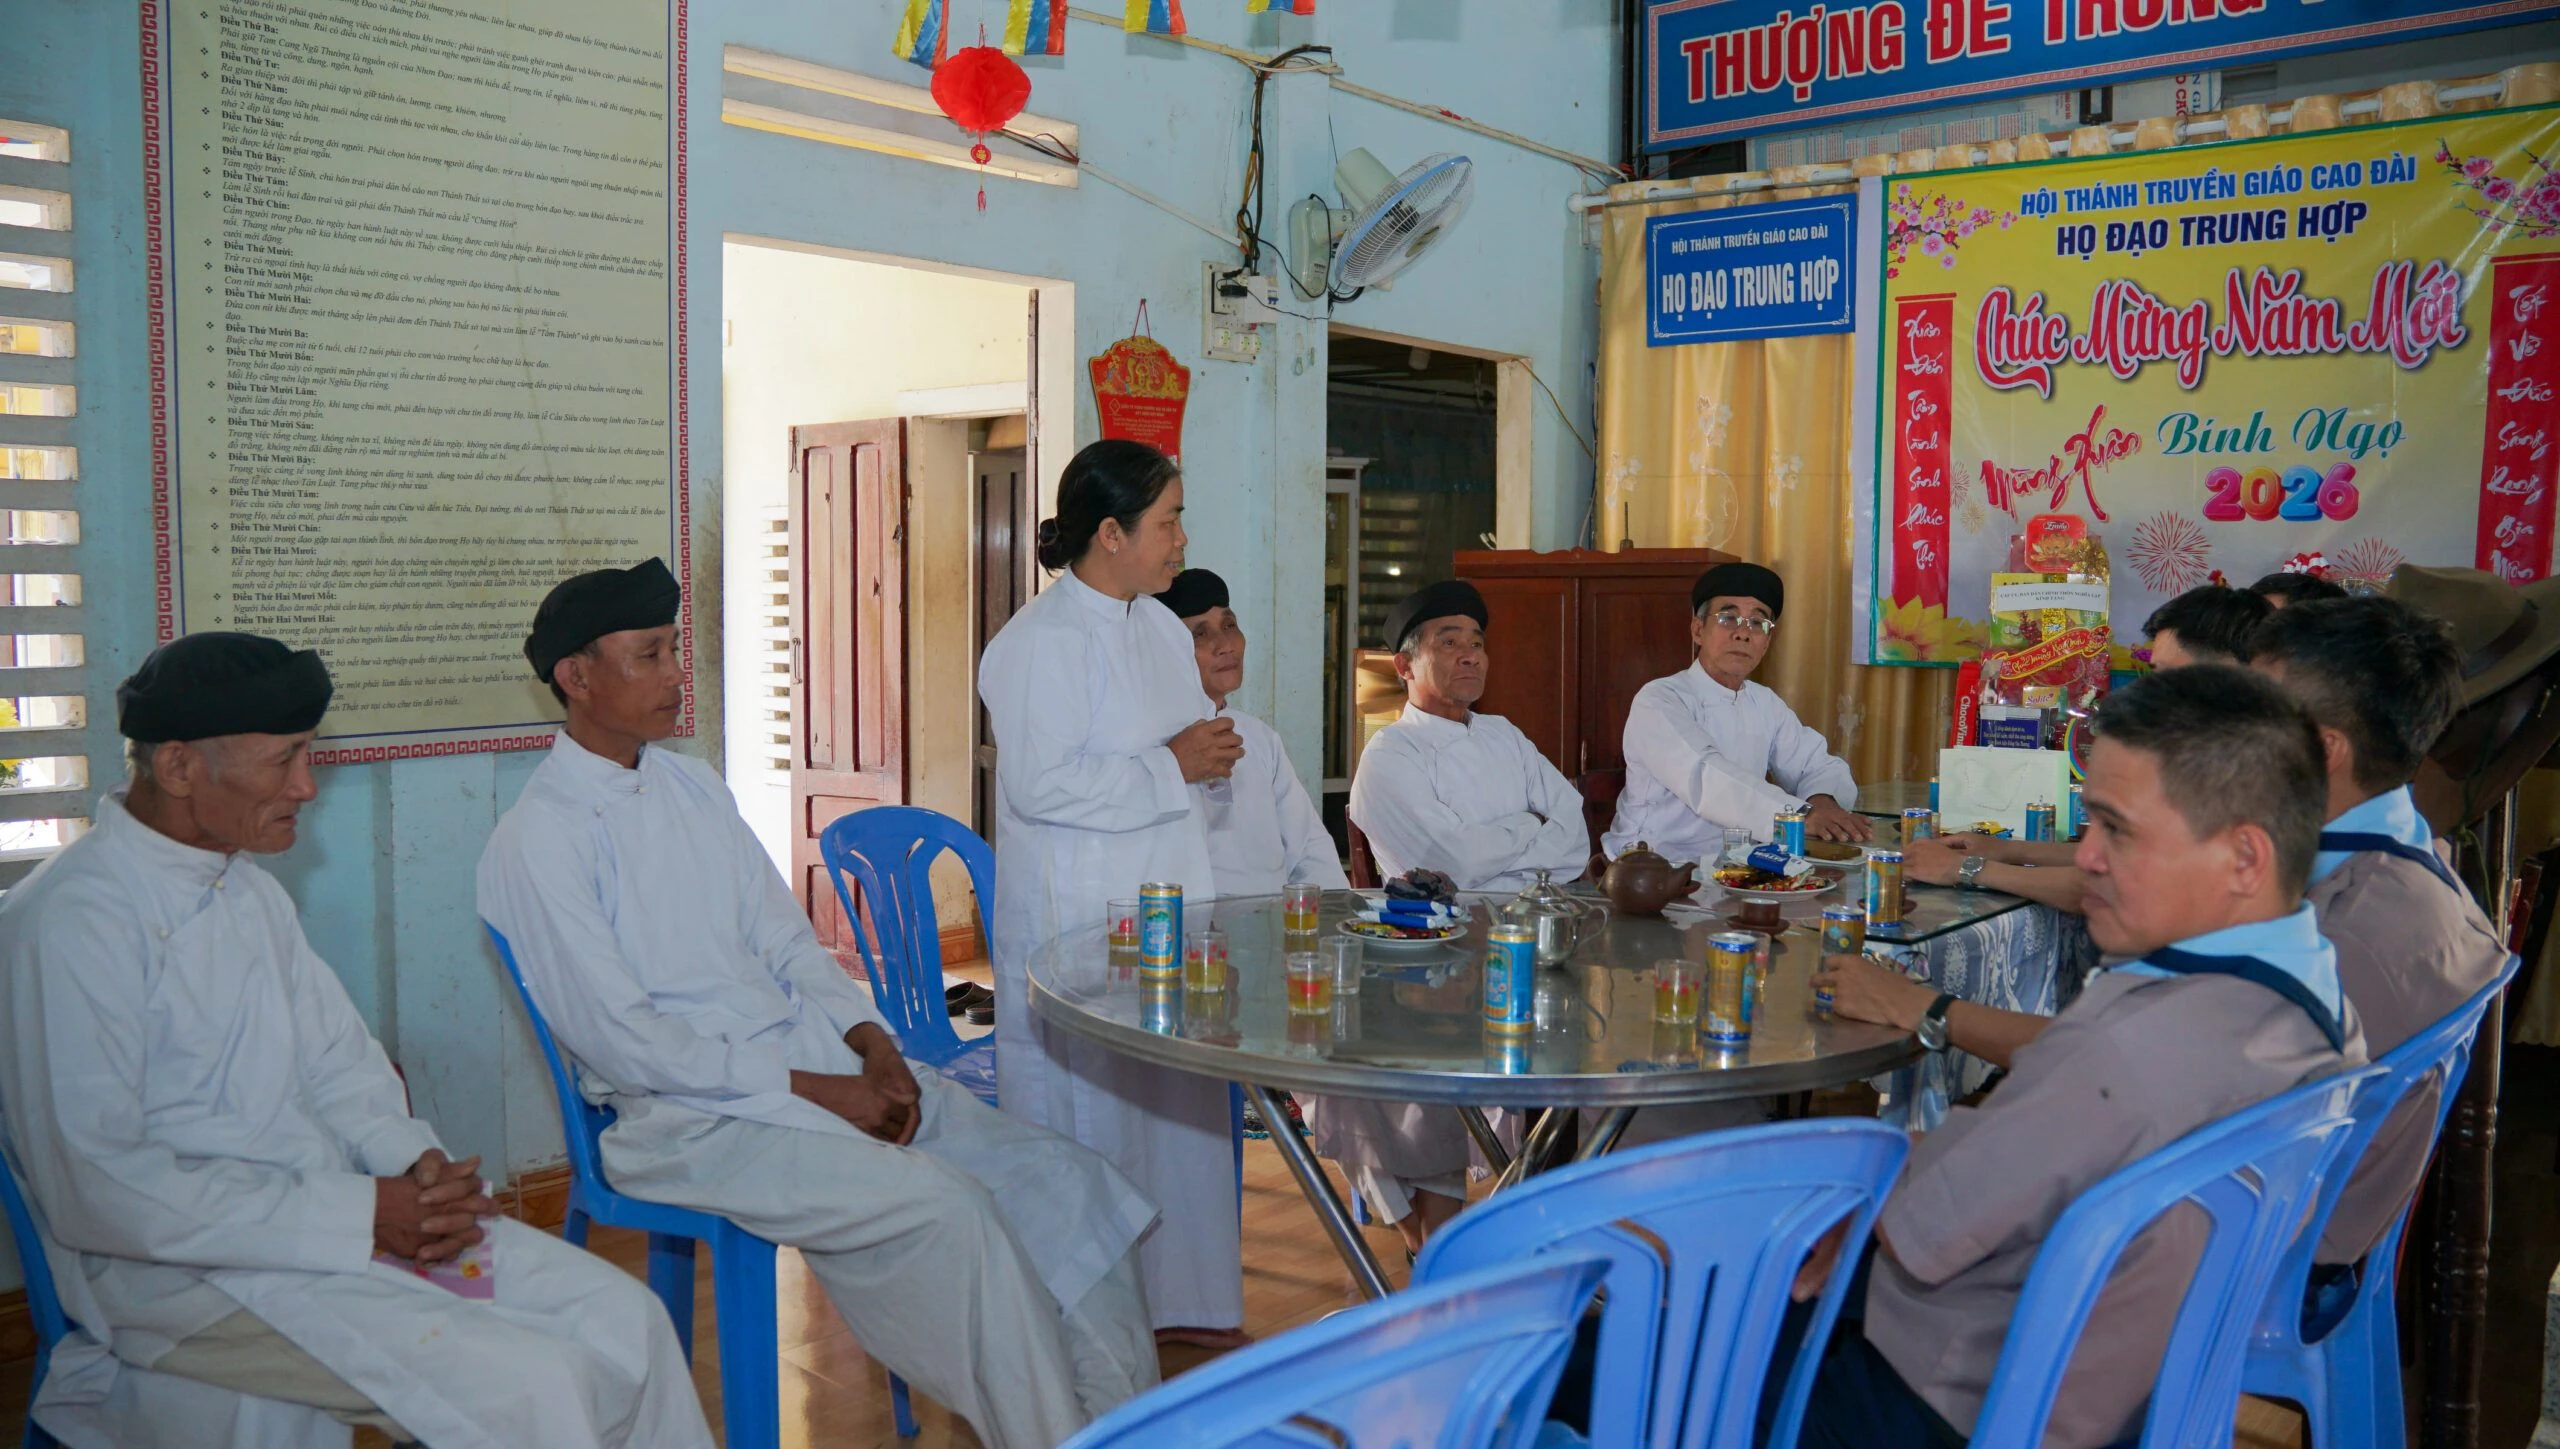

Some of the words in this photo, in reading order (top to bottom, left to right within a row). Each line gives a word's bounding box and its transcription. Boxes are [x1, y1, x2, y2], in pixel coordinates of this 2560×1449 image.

[1682, 3, 1904, 102] THƯỢNG
[2021, 193, 2057, 219] HỘI
[2064, 181, 2138, 212] THÁNH
[2144, 168, 2236, 206] TRUYỀN
[2244, 164, 2302, 196] GIÁO
[2311, 165, 2362, 188] CAO
[2370, 153, 2416, 184] ĐÀI
[1672, 238, 1687, 255] HỘI
[1690, 235, 1720, 252] THÁNH
[1763, 228, 1785, 244] GIÁO
[1789, 228, 1808, 240] CAO
[1810, 223, 1828, 239] ĐÀI
[2057, 225, 2096, 260] HỌ
[2106, 219, 2168, 258] ĐẠO
[2179, 209, 2287, 246] TRUNG
[2297, 200, 2367, 243] HỢP
[1662, 273, 1685, 322] HỌ
[1691, 269, 1728, 319] ĐẠO
[1733, 262, 1795, 307] TRUNG
[1800, 255, 1839, 310] HỢP
[1973, 286, 2068, 399] Chúc
[2070, 278, 2207, 390] Mừng
[2212, 265, 2346, 358] Năm
[2347, 259, 2467, 370] Mới
[2292, 407, 2405, 460] Ngọ
[2204, 462, 2360, 522] 2026
